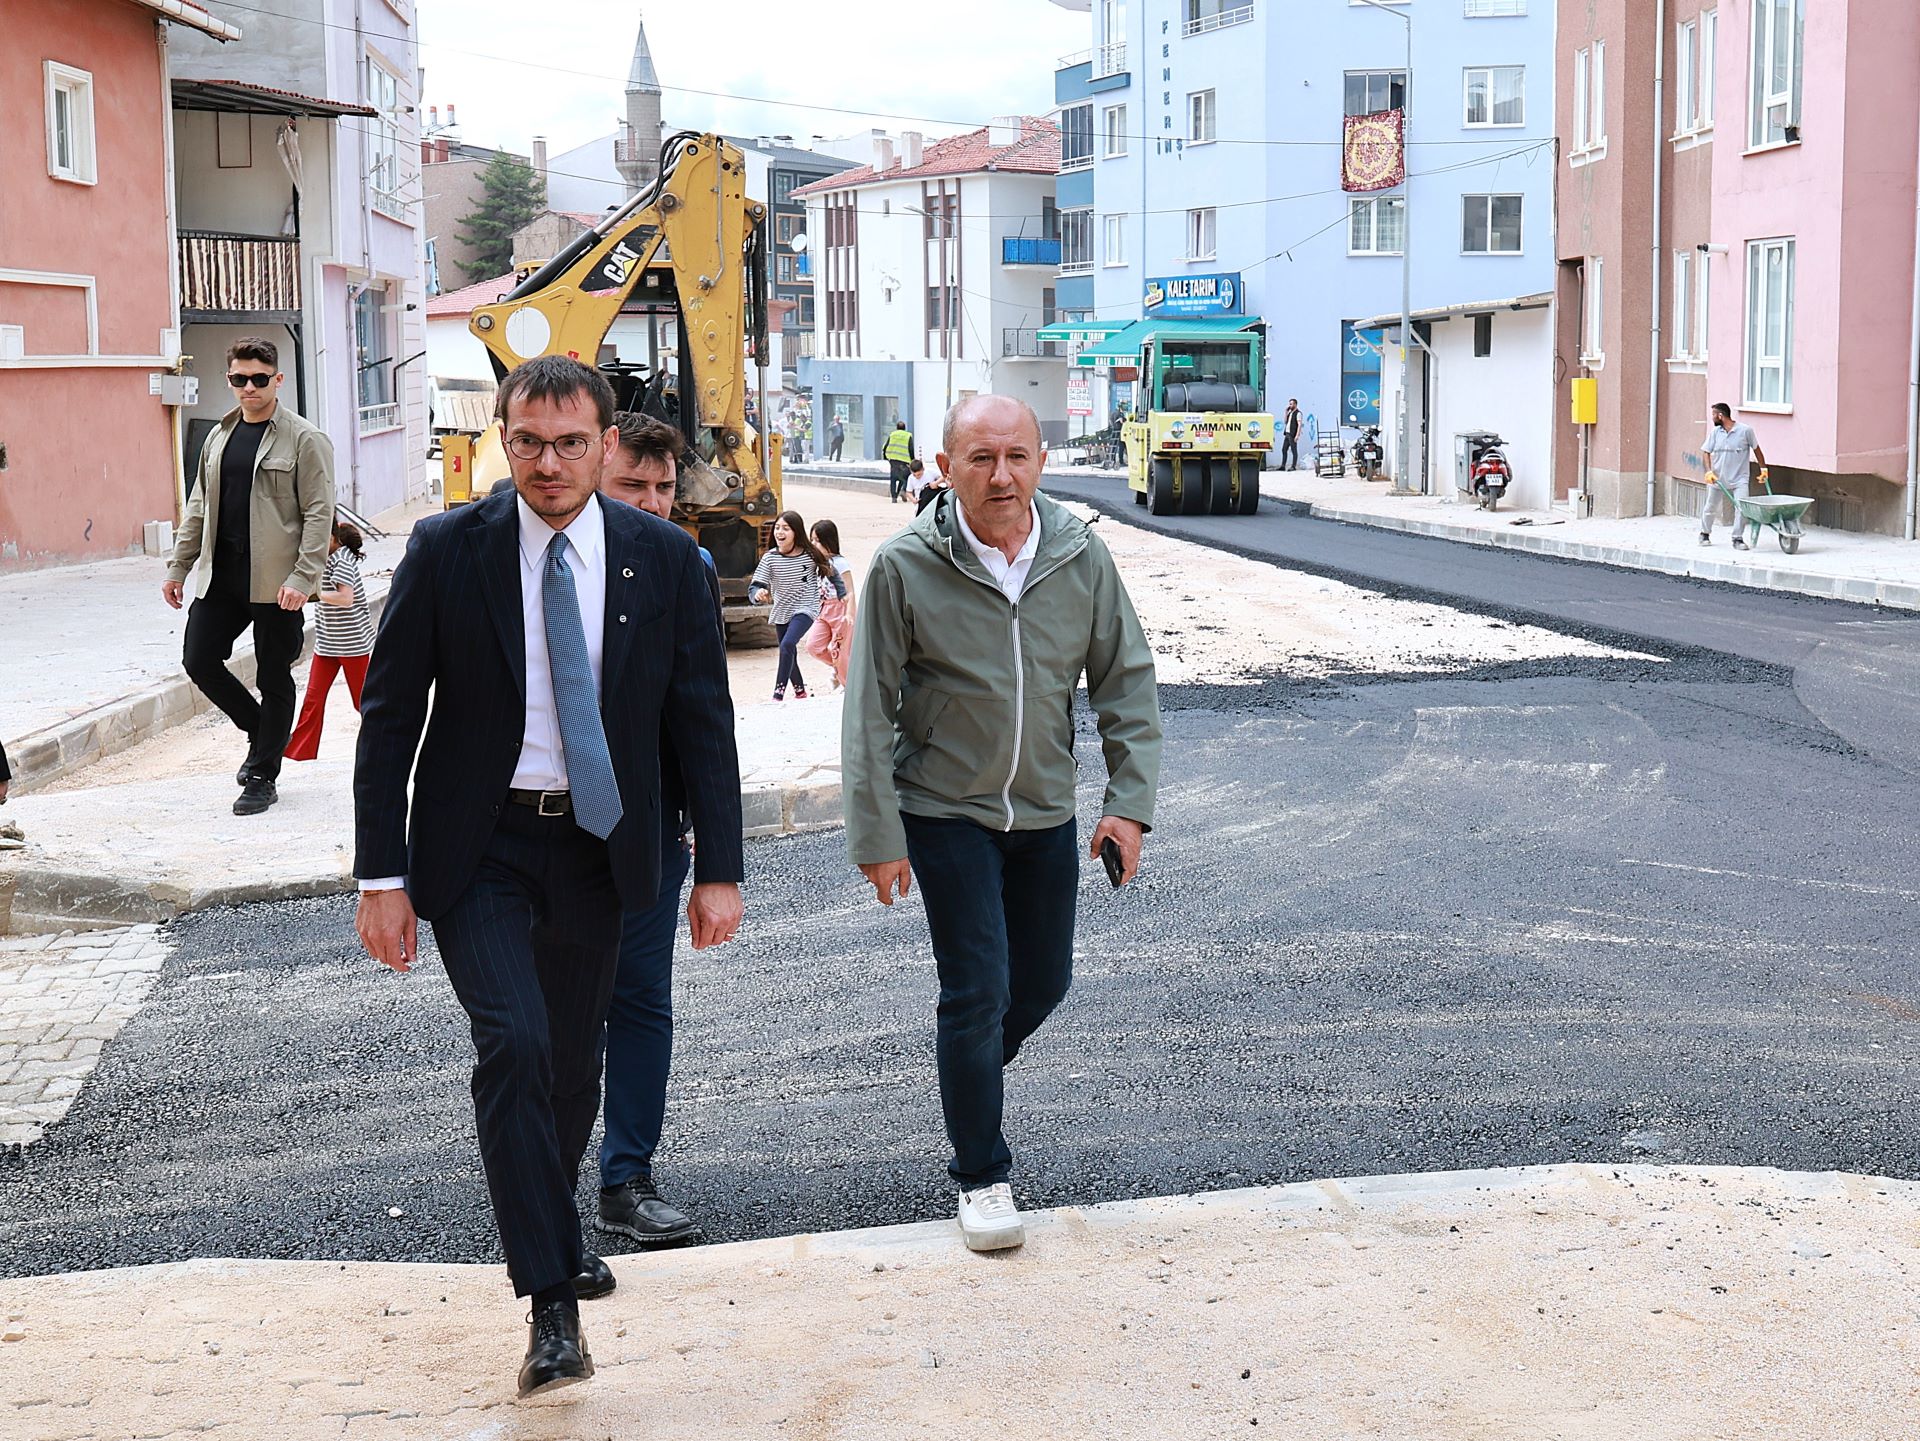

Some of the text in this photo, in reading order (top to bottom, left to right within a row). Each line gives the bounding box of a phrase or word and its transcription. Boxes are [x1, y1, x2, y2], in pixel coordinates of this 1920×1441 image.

[1162, 20, 1172, 129] FENER
[603, 241, 640, 284] CAT
[1167, 280, 1189, 298] KALE
[1189, 278, 1217, 297] TARIM
[1069, 332, 1084, 341] KALE
[1086, 332, 1106, 341] TARIM
[1095, 357, 1136, 366] KALE TARIM
[1190, 423, 1242, 432] AMMANN
